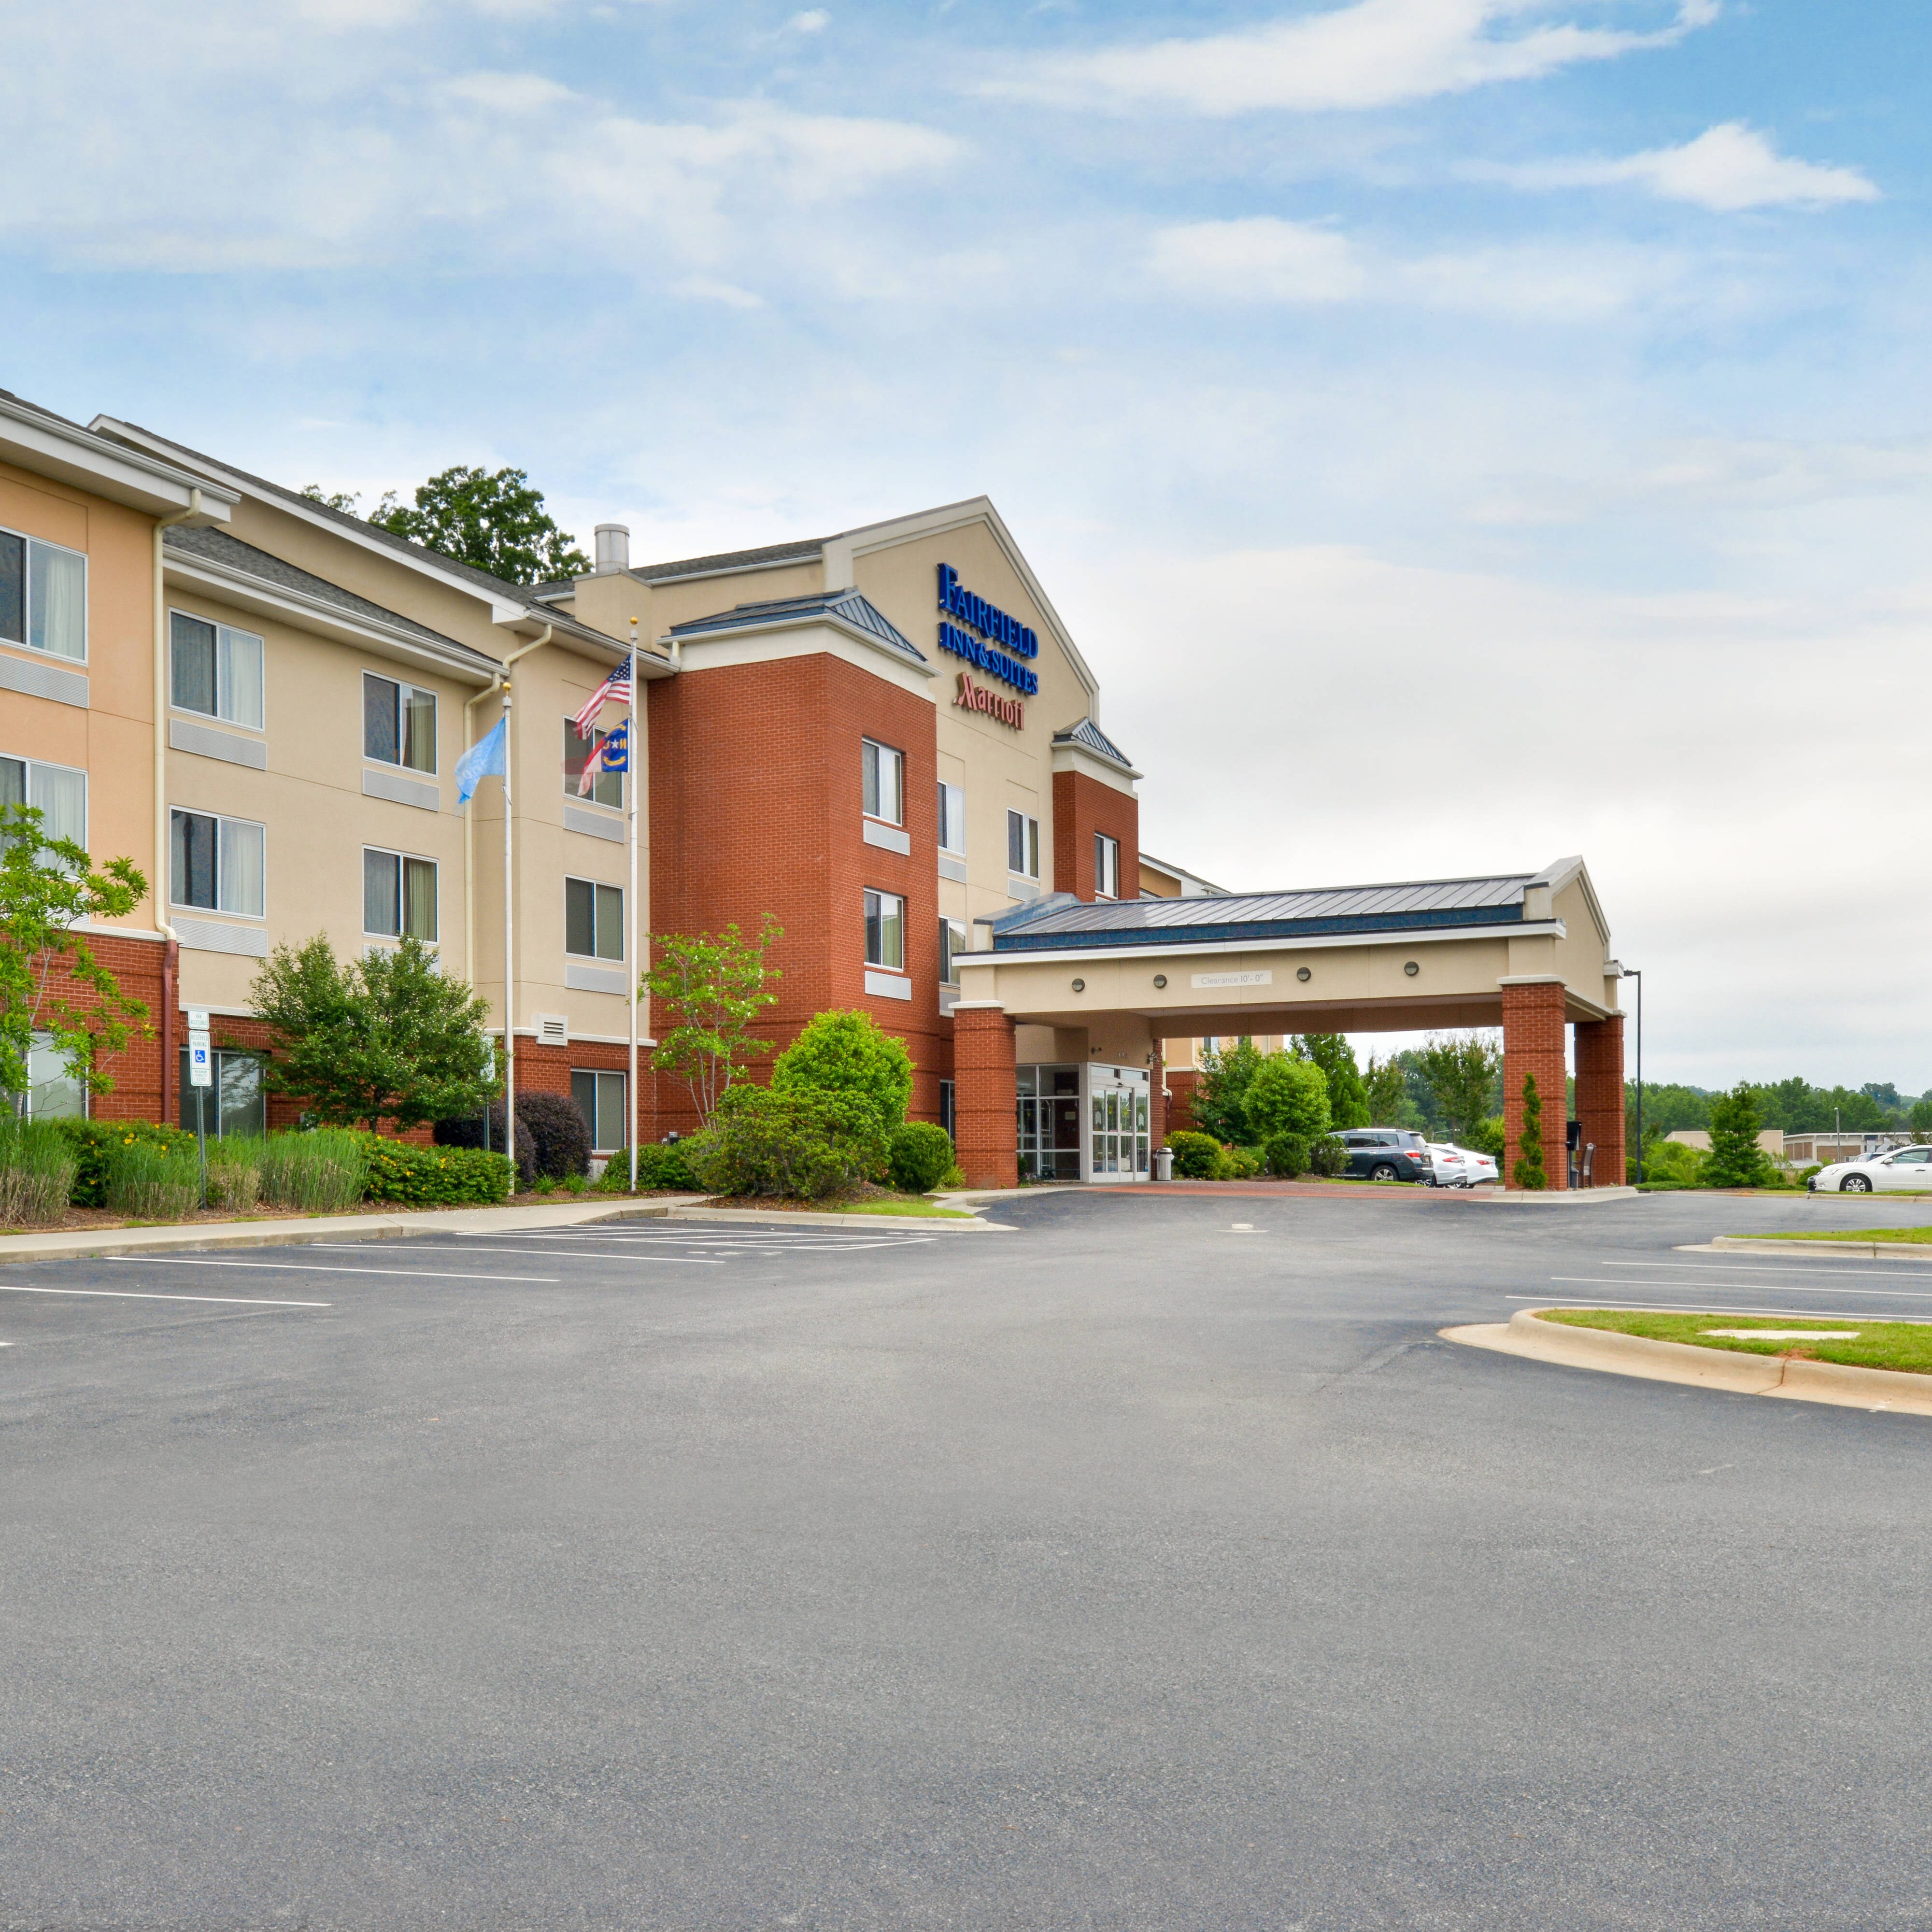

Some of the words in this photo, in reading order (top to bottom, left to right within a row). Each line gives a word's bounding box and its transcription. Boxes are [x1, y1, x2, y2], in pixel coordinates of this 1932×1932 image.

[937, 562, 1038, 659] FAIRFIELD
[938, 621, 976, 662] INN
[986, 649, 1039, 696] SUITES
[957, 671, 1025, 731] Marriott
[1201, 976, 1238, 985] Clearance
